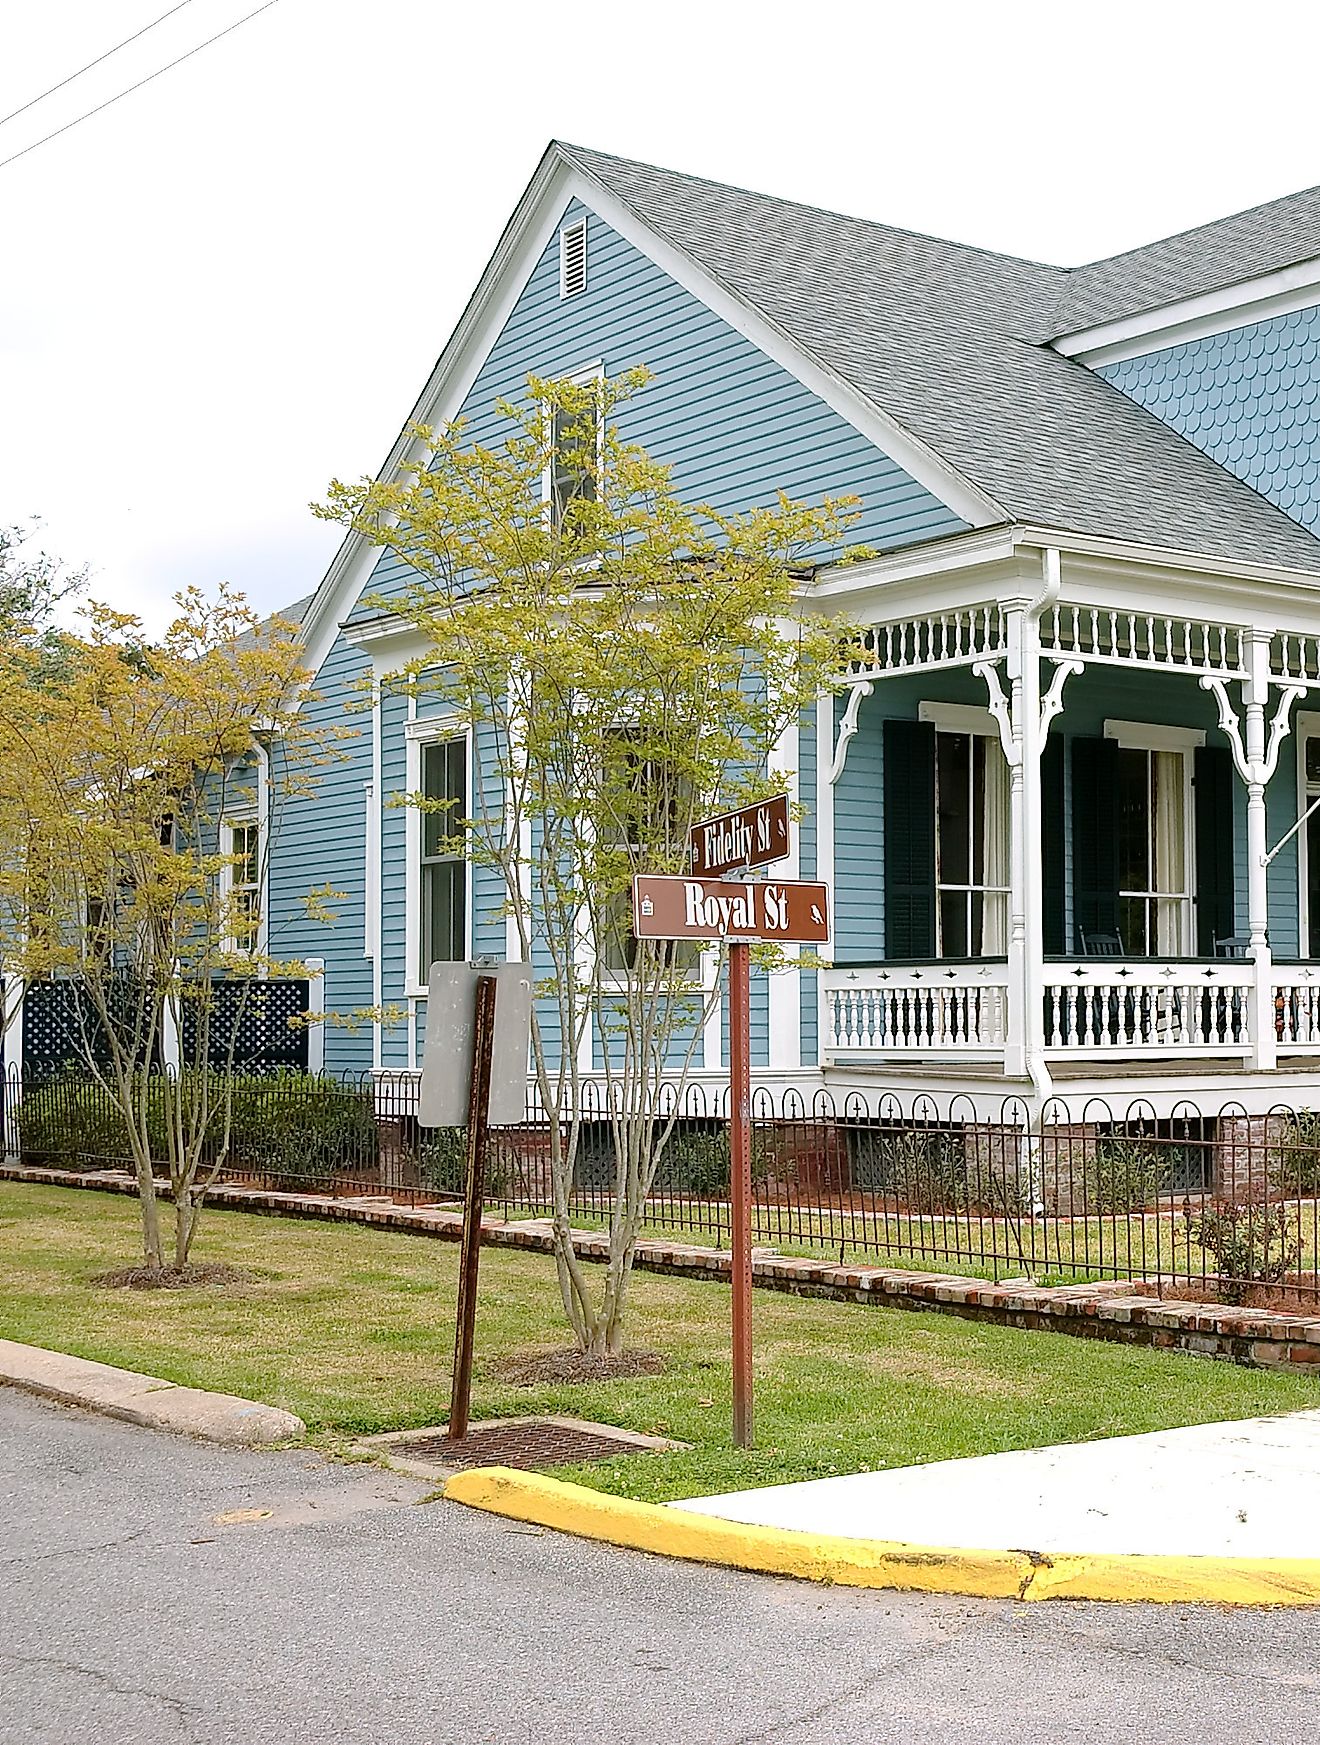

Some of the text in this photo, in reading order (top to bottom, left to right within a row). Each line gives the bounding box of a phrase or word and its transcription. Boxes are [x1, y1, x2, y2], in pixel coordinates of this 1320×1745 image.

[705, 807, 772, 868] Fidelity St
[684, 882, 790, 935] Royal St
